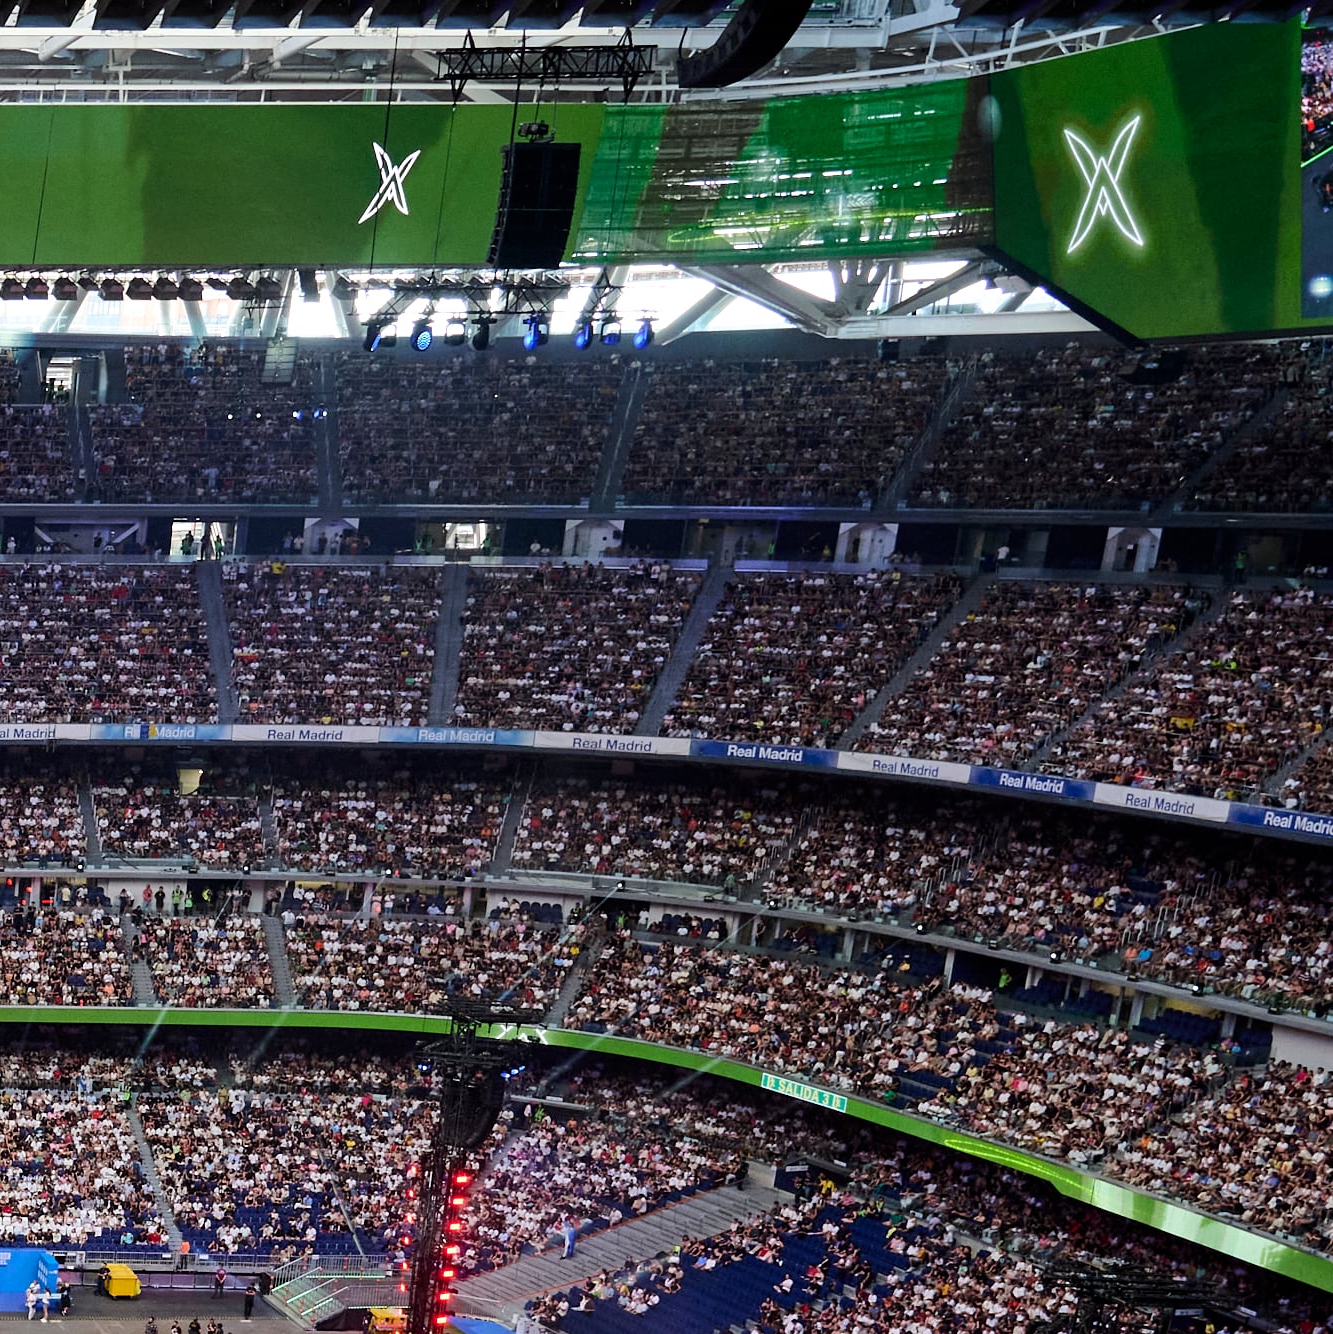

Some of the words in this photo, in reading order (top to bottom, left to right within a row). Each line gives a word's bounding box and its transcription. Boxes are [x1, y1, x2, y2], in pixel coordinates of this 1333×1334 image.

[13, 728, 56, 739] Madrid
[267, 729, 295, 740] Real
[299, 729, 343, 741] Madrid
[417, 729, 444, 741] Real
[449, 729, 495, 742] Madrid
[572, 737, 602, 750] Real
[605, 739, 652, 752] Madrid
[727, 744, 757, 758] Real
[758, 746, 803, 762] Madrid
[872, 759, 897, 772] Real
[900, 762, 939, 777] Madrid
[999, 773, 1024, 788] Real
[1025, 776, 1064, 793] Madrid
[1124, 793, 1151, 808] Real
[1154, 797, 1195, 815] Madrid
[1263, 811, 1293, 829] Real
[778, 1080, 819, 1103] SALIDA
[822, 1094, 830, 1105] 3
